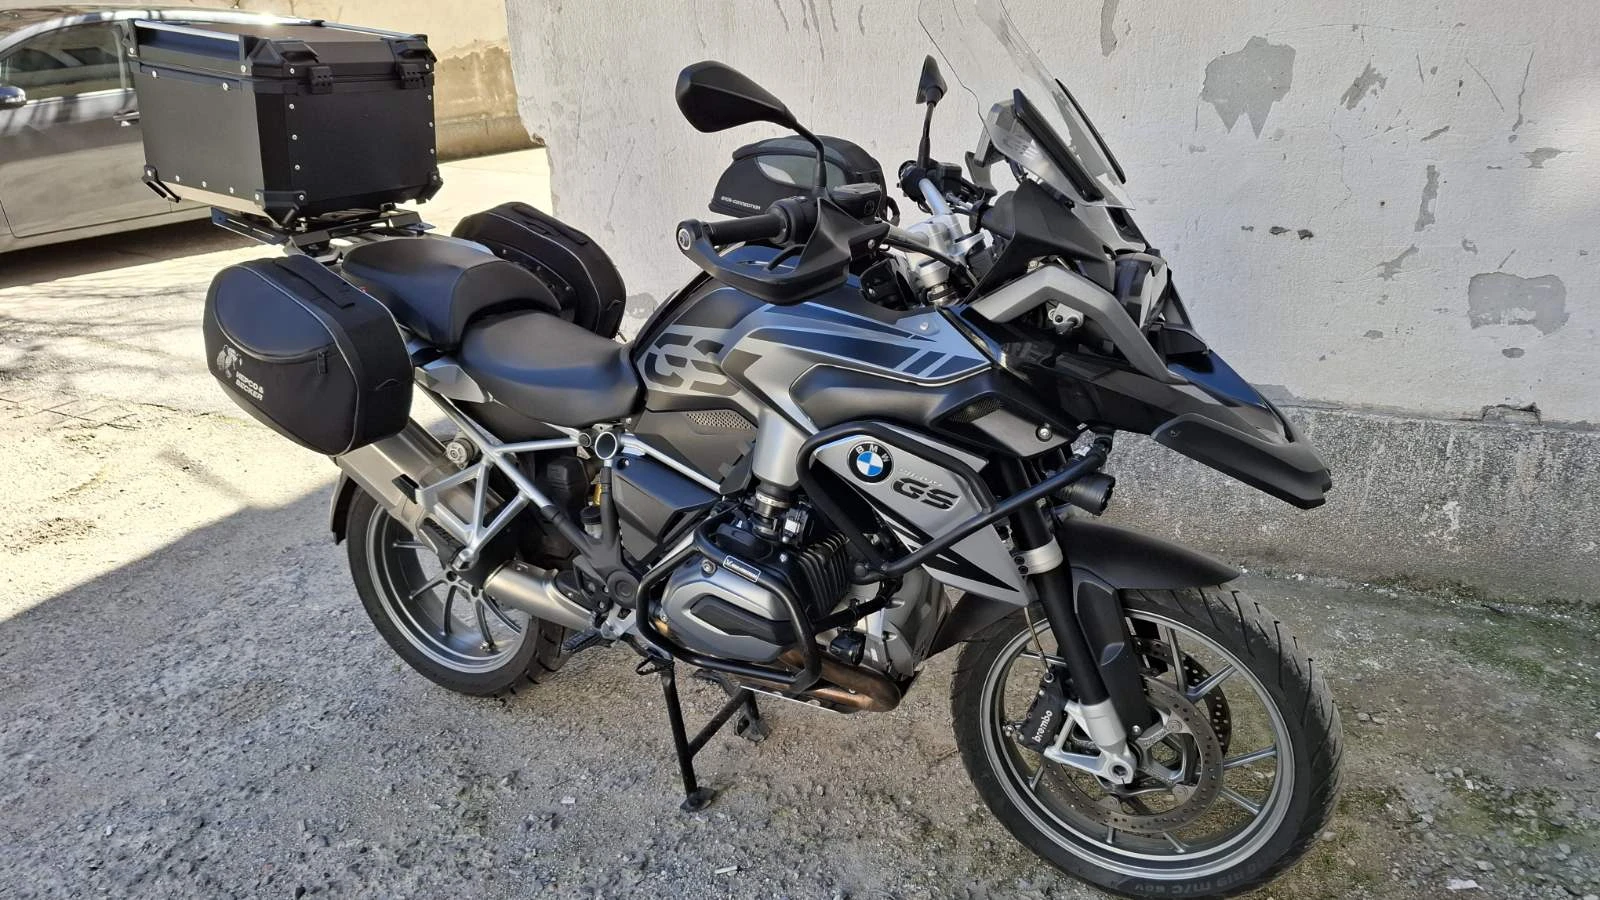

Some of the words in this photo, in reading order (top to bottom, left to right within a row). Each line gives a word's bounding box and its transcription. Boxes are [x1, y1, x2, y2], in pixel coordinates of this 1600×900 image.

[235, 371, 258, 390] HEPCO
[235, 379, 264, 401] BECKER
[855, 444, 891, 463] BMW
[893, 477, 960, 510] GS
[1031, 710, 1053, 743] brembo
